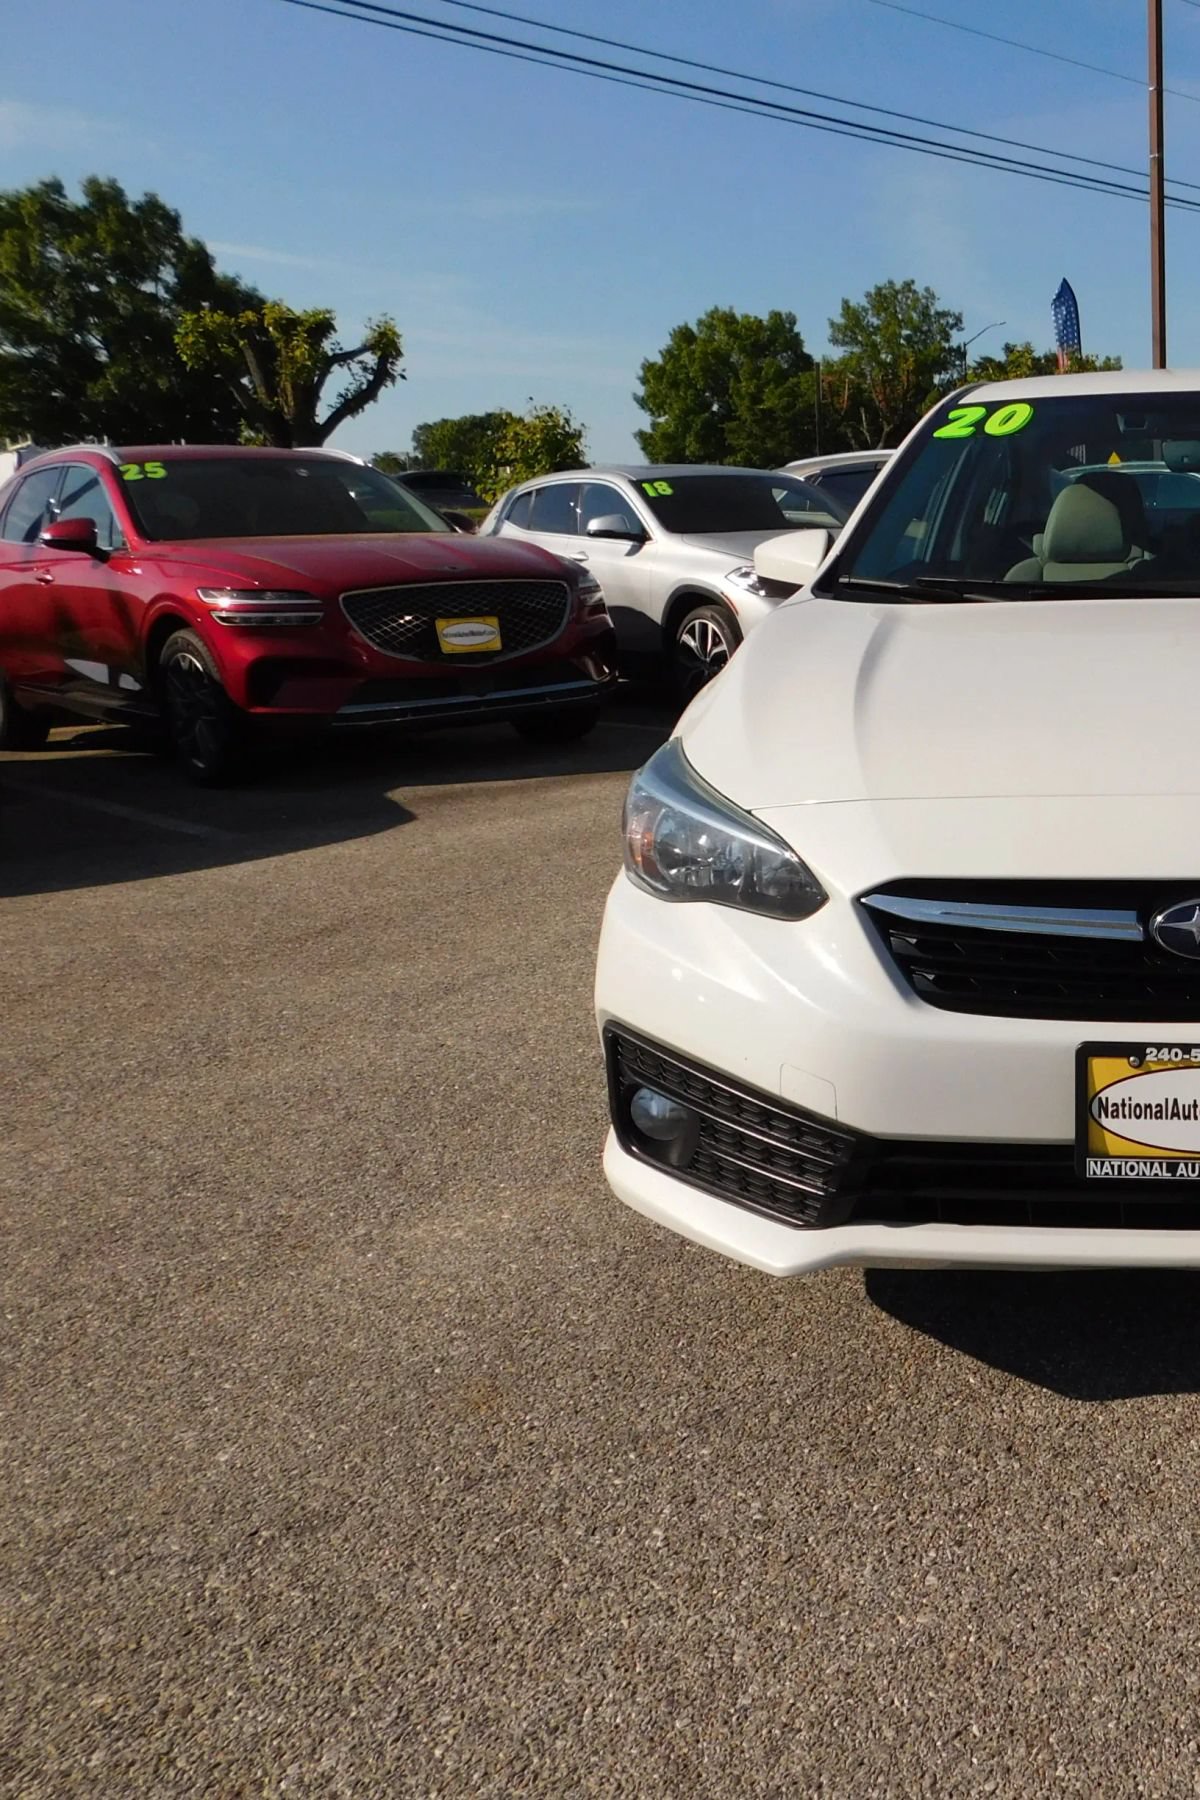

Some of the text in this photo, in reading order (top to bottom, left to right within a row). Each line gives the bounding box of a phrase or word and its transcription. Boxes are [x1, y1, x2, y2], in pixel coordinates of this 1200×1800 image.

[933, 403, 1034, 438] 20
[118, 461, 168, 481] 25
[641, 481, 674, 497] 18
[1088, 1160, 1172, 1178] NATIONAL
